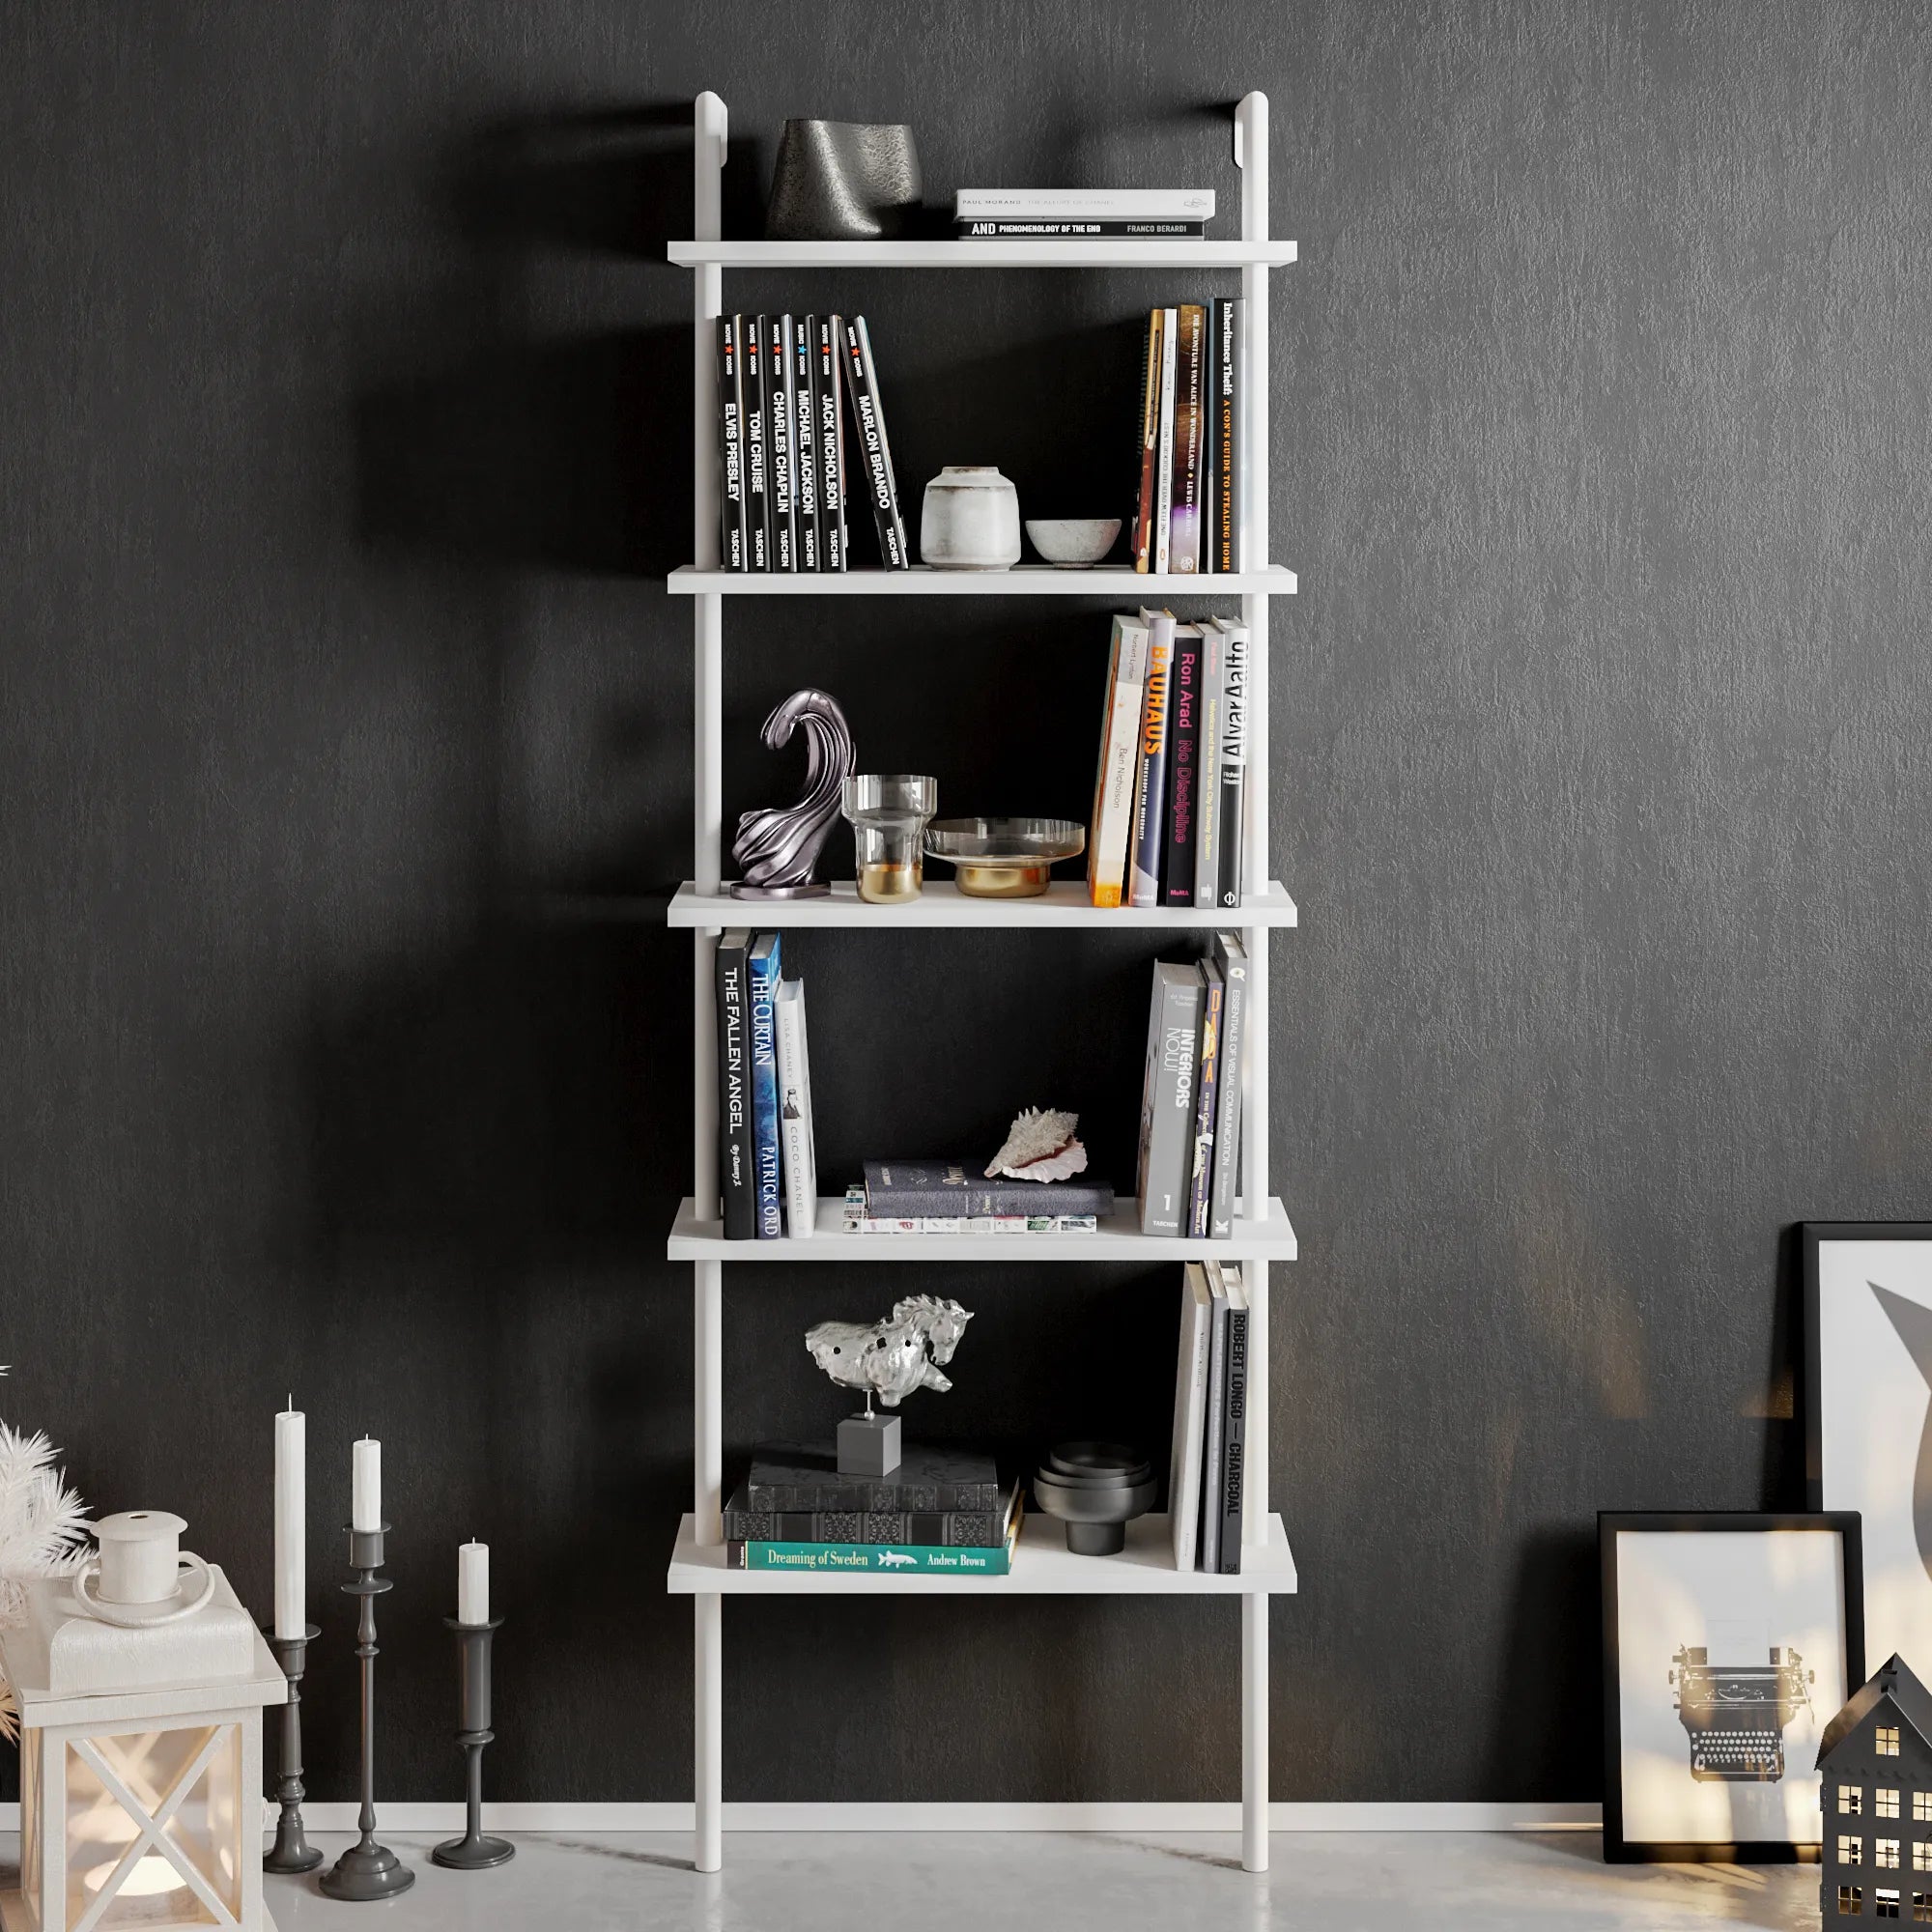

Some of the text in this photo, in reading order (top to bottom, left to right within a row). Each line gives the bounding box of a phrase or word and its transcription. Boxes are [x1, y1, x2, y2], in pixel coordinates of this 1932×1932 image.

[972, 223, 1101, 236] AND PHENOMENOLOGY OF THE END
[1222, 301, 1234, 363] Inheritance
[1222, 364, 1234, 396] Theif:
[1190, 407, 1198, 416] IN
[1223, 409, 1232, 439] CON'S
[724, 403, 740, 501] ELVIS PRESLEY
[750, 411, 764, 494] TOM CRUISE
[773, 390, 789, 513] CHARLES CHAPLIN
[798, 389, 814, 515] MICHAEL JACKSON
[821, 393, 838, 510] JACK NICHOLSON
[858, 394, 891, 510] MARLON BRANDO
[1187, 417, 1197, 470] WONDERLAND
[1223, 440, 1232, 472] GUIDE
[1185, 481, 1194, 503] LEWIS
[1223, 474, 1232, 489] TO
[1222, 491, 1232, 539] STEALING
[730, 528, 740, 567] TASCHEN
[754, 528, 764, 567] TASCHEN
[780, 528, 789, 567] TASCHEN
[805, 528, 815, 567] TASCHEN
[829, 528, 839, 567] TASCHEN
[886, 526, 900, 565] TASCHEN
[1222, 541, 1232, 571] HOME
[1144, 645, 1169, 755] BAUHAUS
[1208, 698, 1217, 731] Helvetica
[1222, 641, 1249, 759] Alvar Aalto
[1173, 652, 1196, 843] Ron Arad No Discipline
[1208, 731, 1216, 745] and
[1112, 748, 1128, 809] Ben Nicholson
[1142, 758, 1151, 793] WORKSHOPS
[1207, 757, 1215, 774] New
[1205, 791, 1213, 806] City
[1139, 807, 1148, 840] MODERNITY
[1204, 806, 1212, 834] Subway
[1204, 834, 1212, 861] System
[752, 973, 773, 1066] THE CURTAIN
[724, 967, 743, 1134] THE FALLEN ANGEL
[784, 1041, 794, 1079] CHANEY
[1163, 1027, 1181, 1072] NOW!
[1175, 1028, 1196, 1109] INTERIORS
[1205, 1092, 1210, 1100] IN
[1221, 989, 1241, 1166] ESSENTIALS OF VISUAL COMMUNICATION
[729, 1144, 741, 1155] By
[730, 1155, 741, 1179] Danny
[789, 1126, 804, 1215] COCO CHANEL
[1198, 1166, 1207, 1191] Museum
[761, 1146, 779, 1236] PATRICK ORD
[1164, 1194, 1171, 1211] 1
[1195, 1200, 1204, 1224] Modern
[1227, 1314, 1246, 1518] ROBERT LONGO CHARCOAL
[768, 1549, 868, 1569] Dreaming of Sweden
[926, 1553, 986, 1567] Andrew Brown
